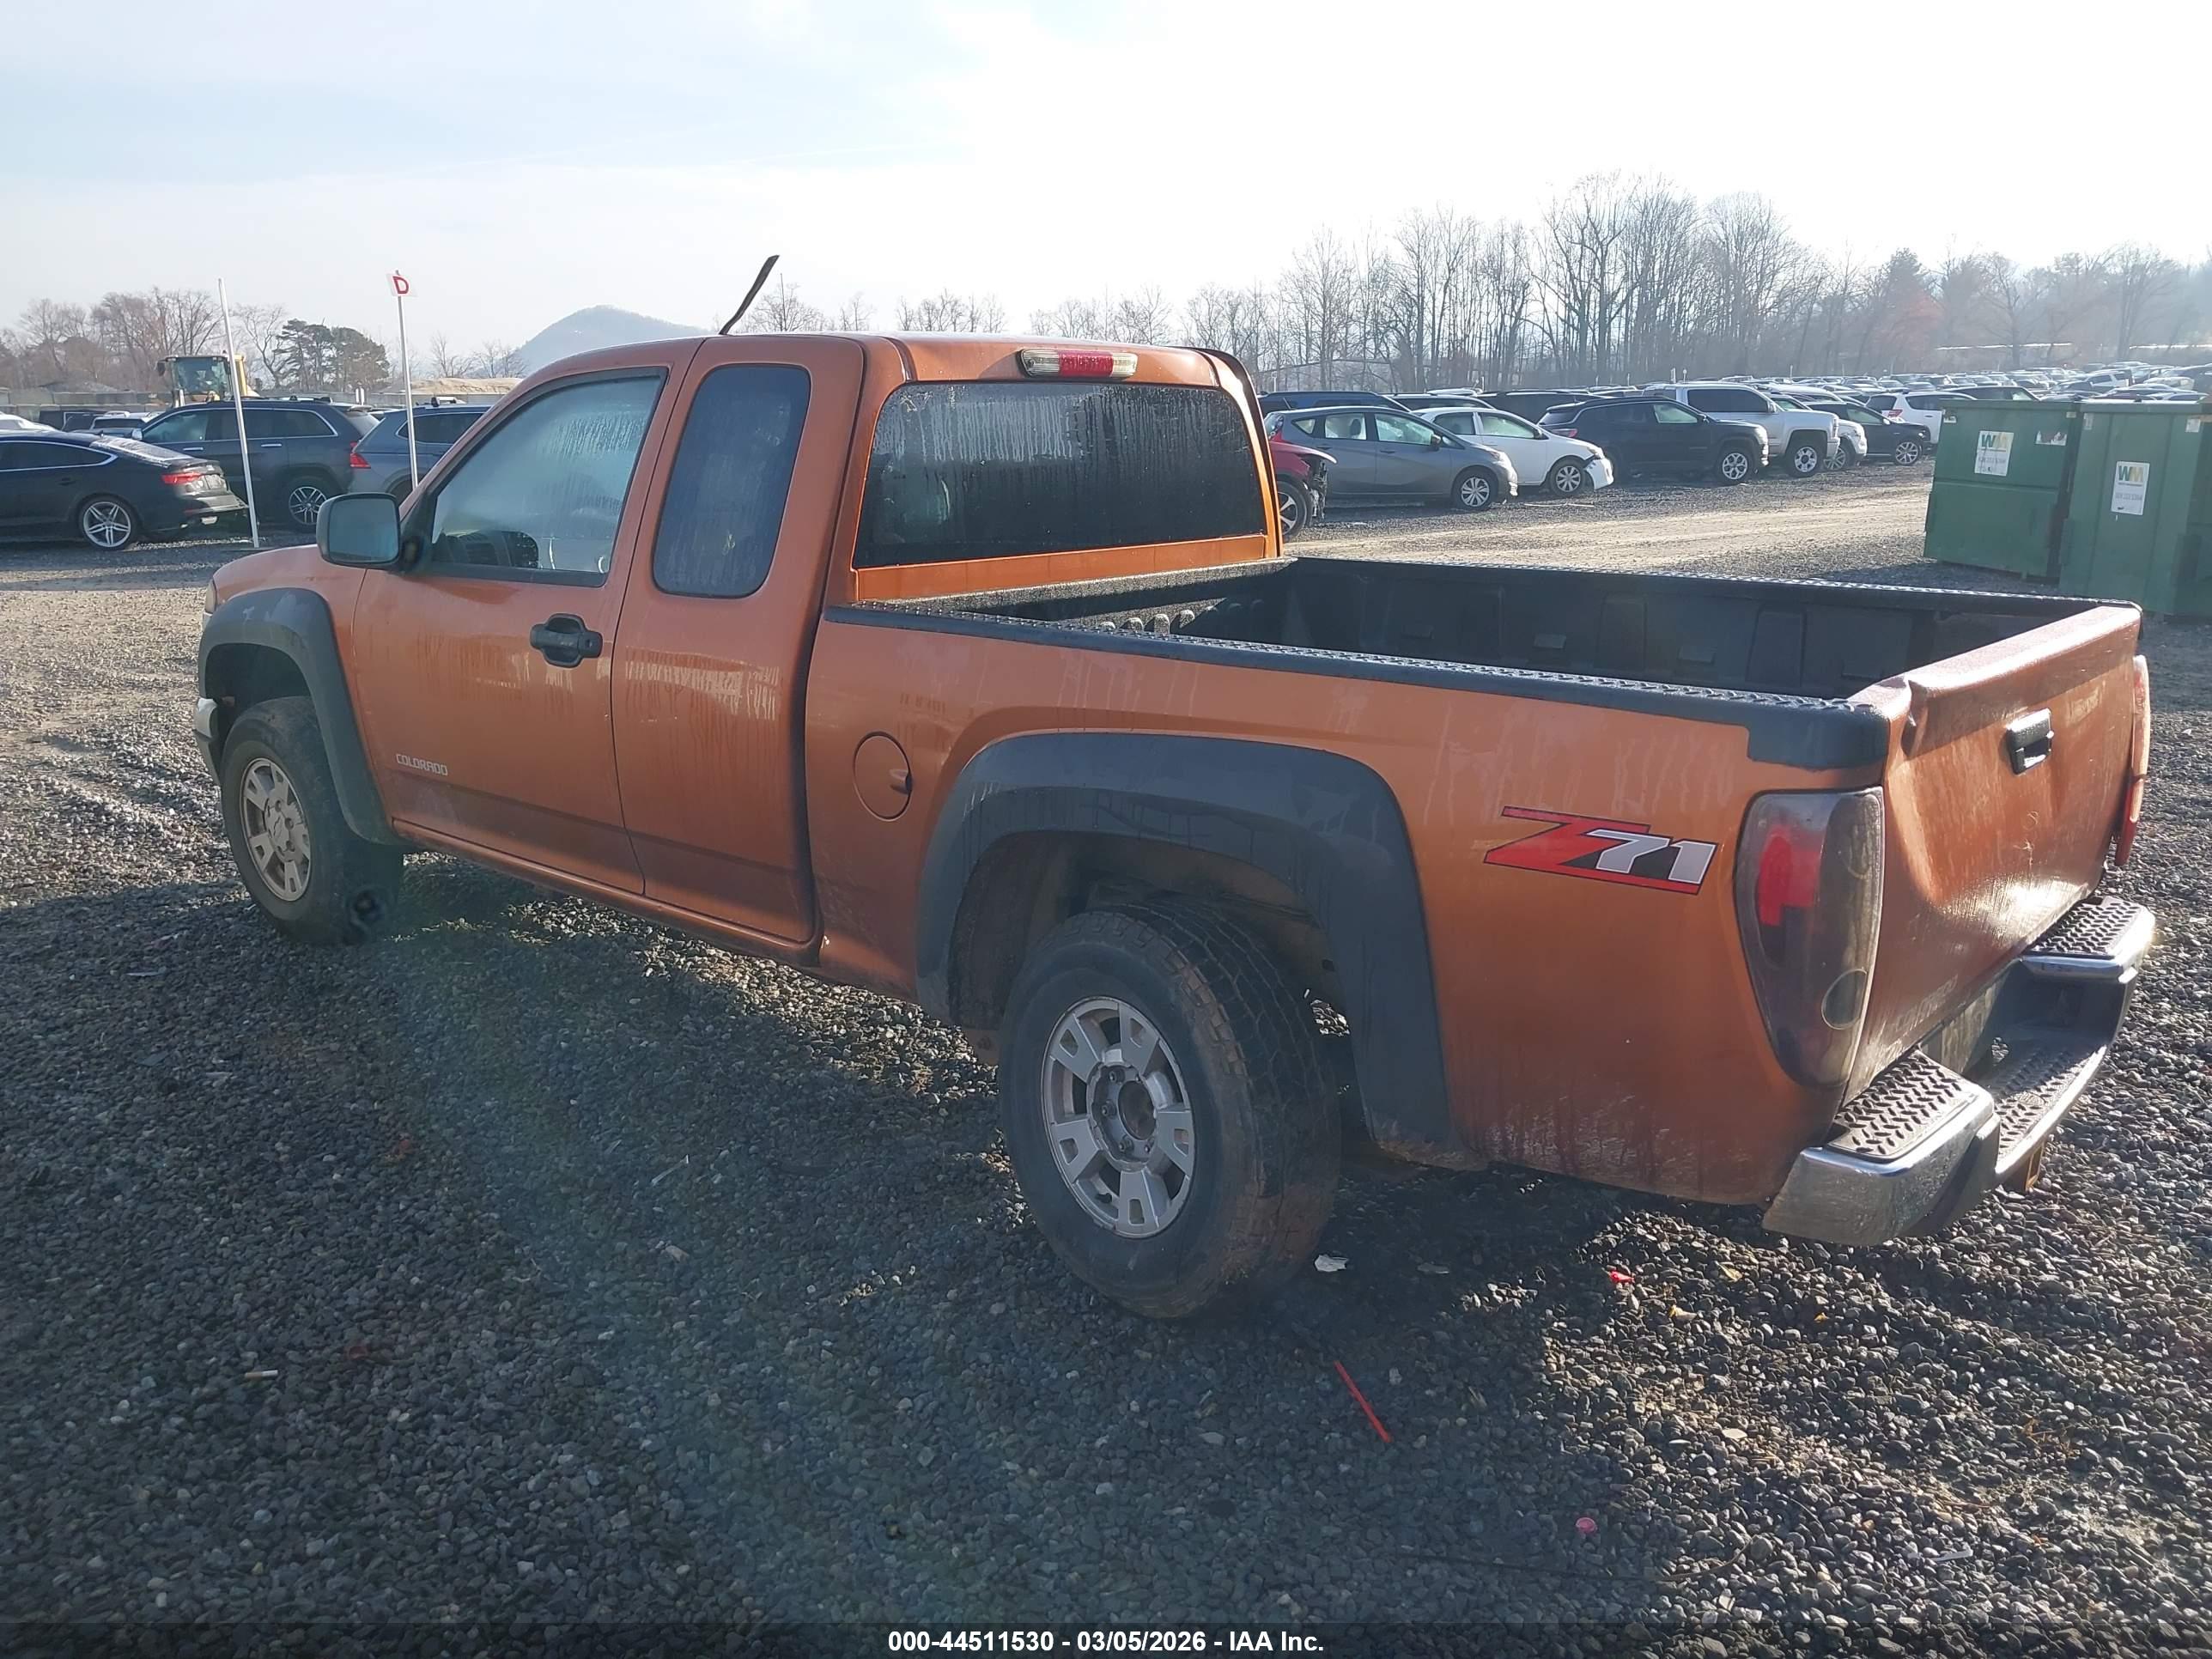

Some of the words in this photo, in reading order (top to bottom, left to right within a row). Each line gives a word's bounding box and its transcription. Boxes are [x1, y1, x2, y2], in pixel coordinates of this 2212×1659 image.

[392, 276, 409, 294] D
[1981, 434, 2007, 449] WM
[2118, 465, 2143, 483] WM
[396, 754, 448, 776] COLORADO
[1483, 805, 1717, 896] Z71
